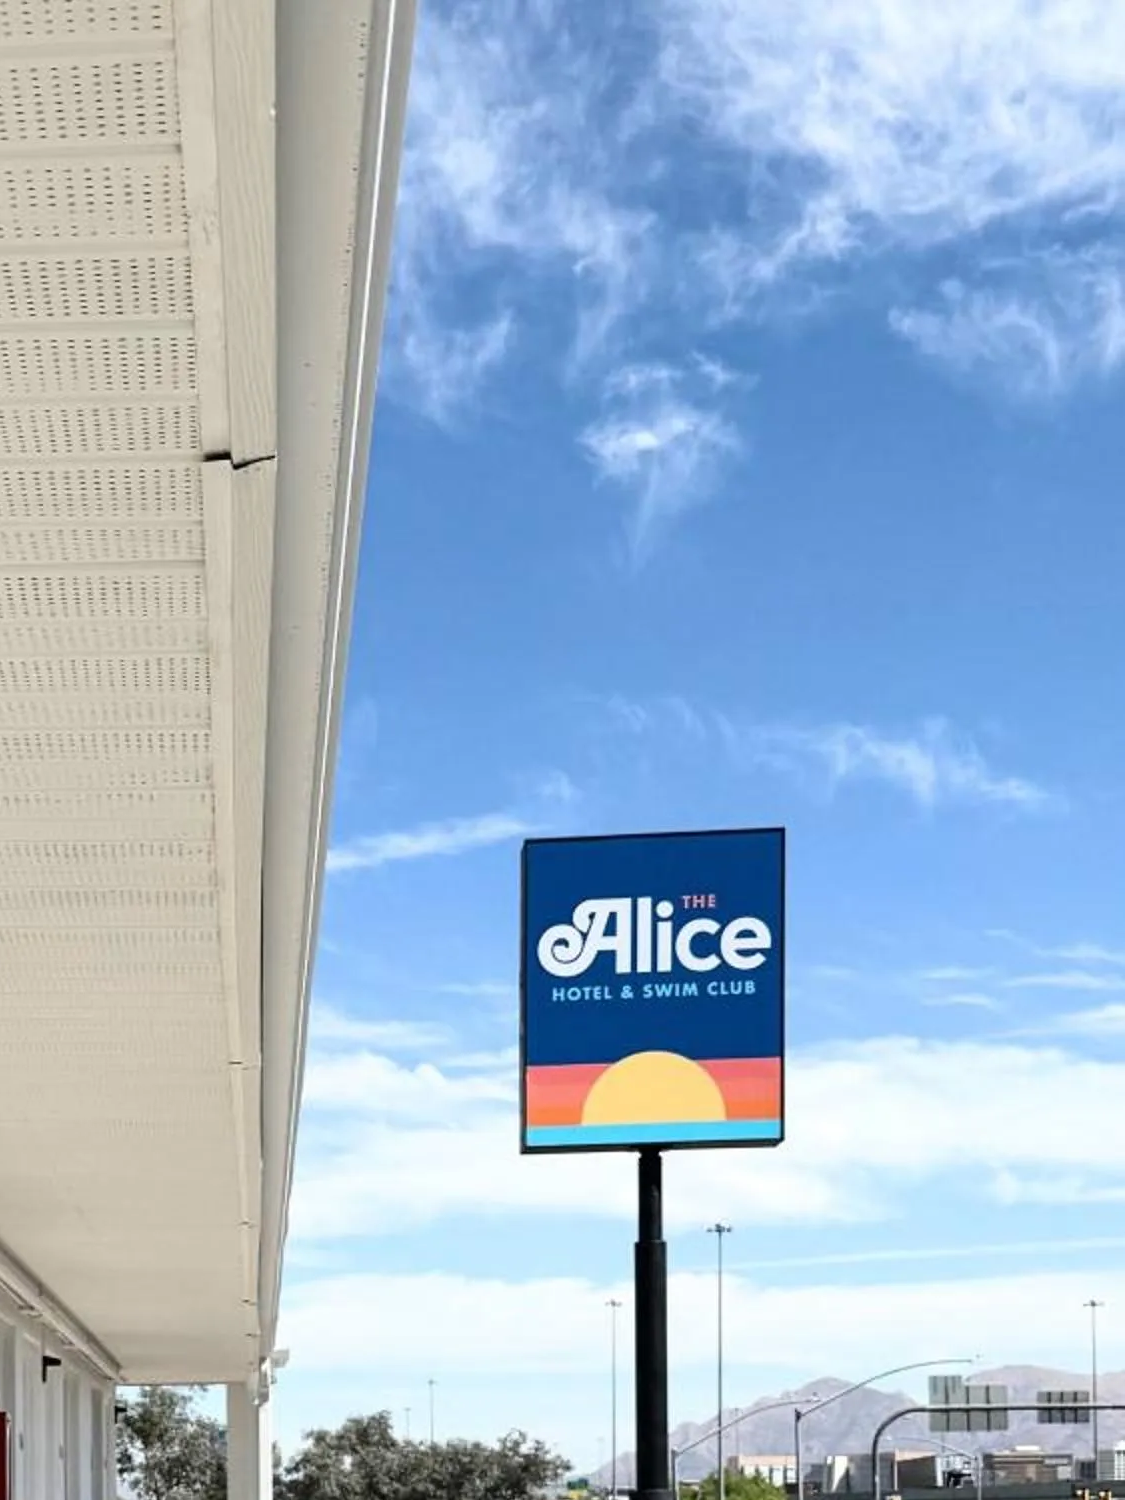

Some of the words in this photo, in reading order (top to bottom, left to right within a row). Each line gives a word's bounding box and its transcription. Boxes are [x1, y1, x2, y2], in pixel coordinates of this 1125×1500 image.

[682, 894, 716, 909] THE
[537, 896, 772, 977] Alice
[551, 985, 613, 1002] HOTEL
[620, 982, 634, 999] &
[642, 981, 700, 999] SWIM
[706, 980, 757, 996] CLUB
